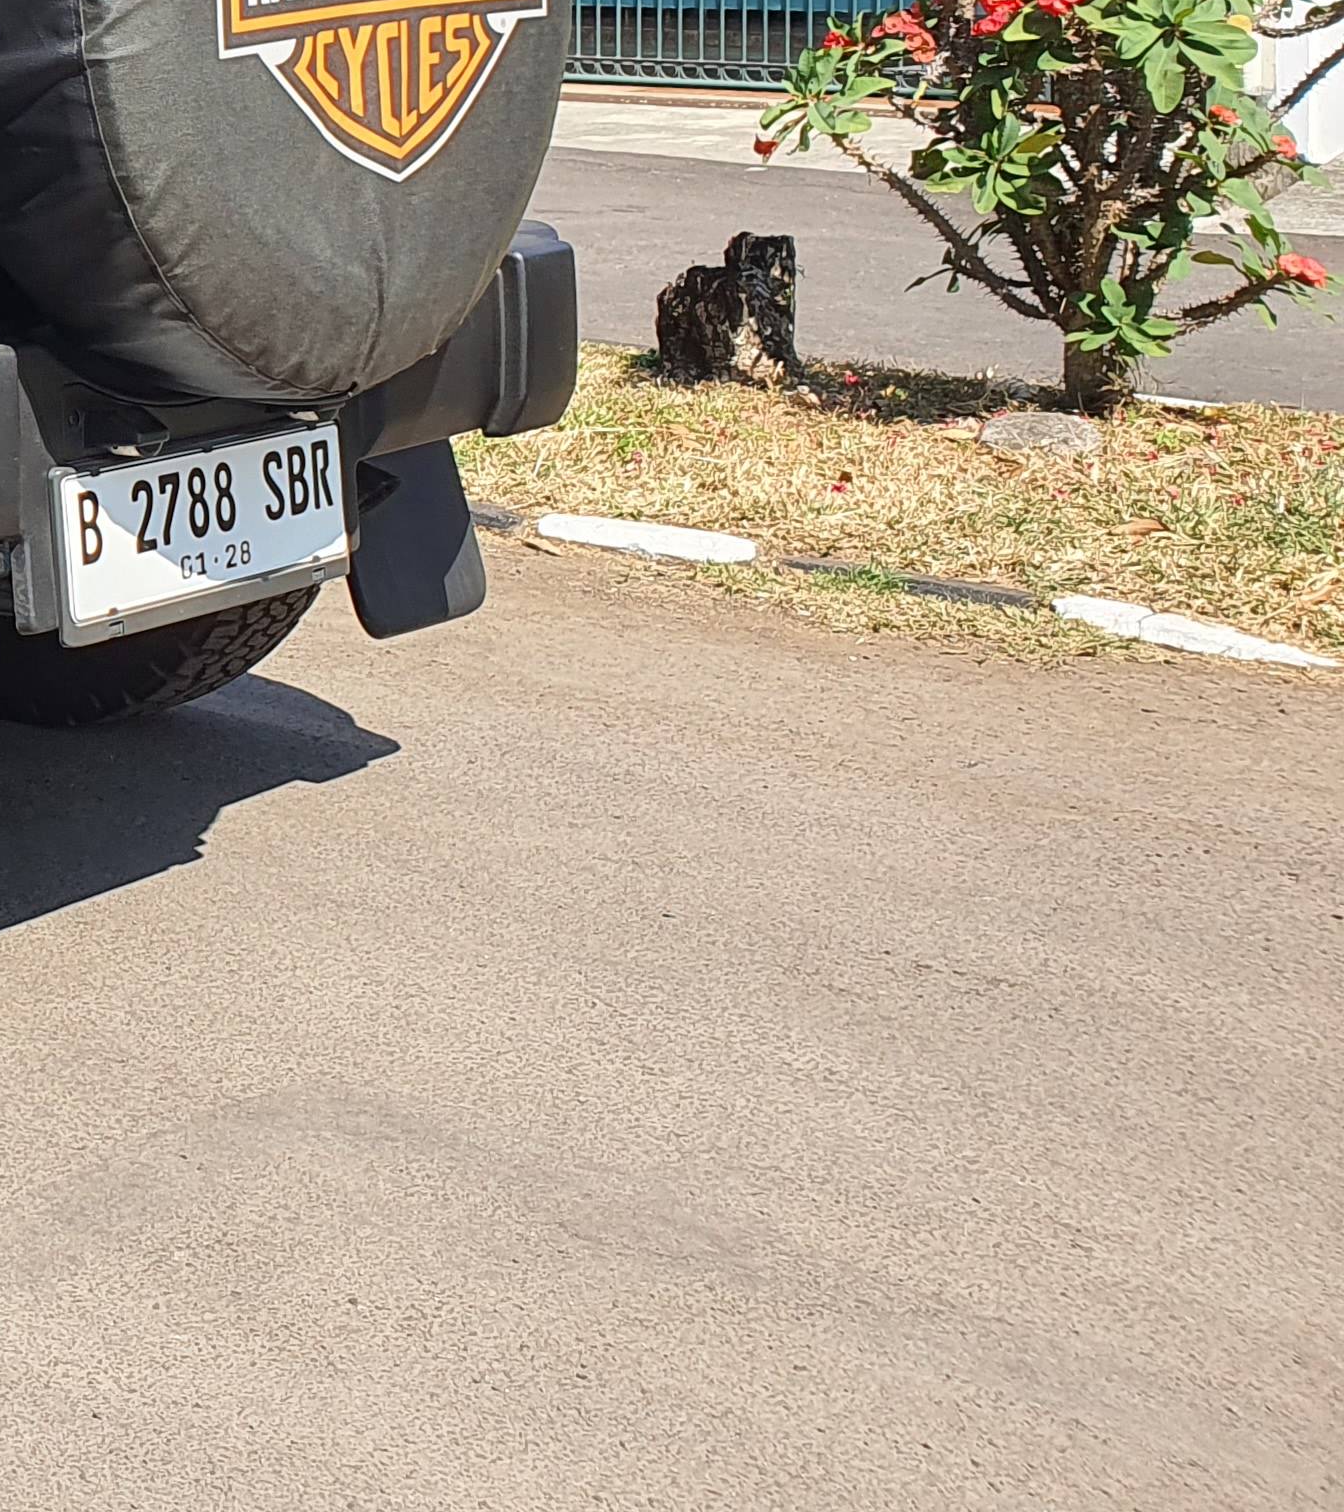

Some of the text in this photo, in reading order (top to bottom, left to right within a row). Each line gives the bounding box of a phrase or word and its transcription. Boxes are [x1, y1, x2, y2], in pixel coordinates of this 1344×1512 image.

[315, 13, 469, 138] CYCLES
[77, 440, 334, 566] B 2788 SBR
